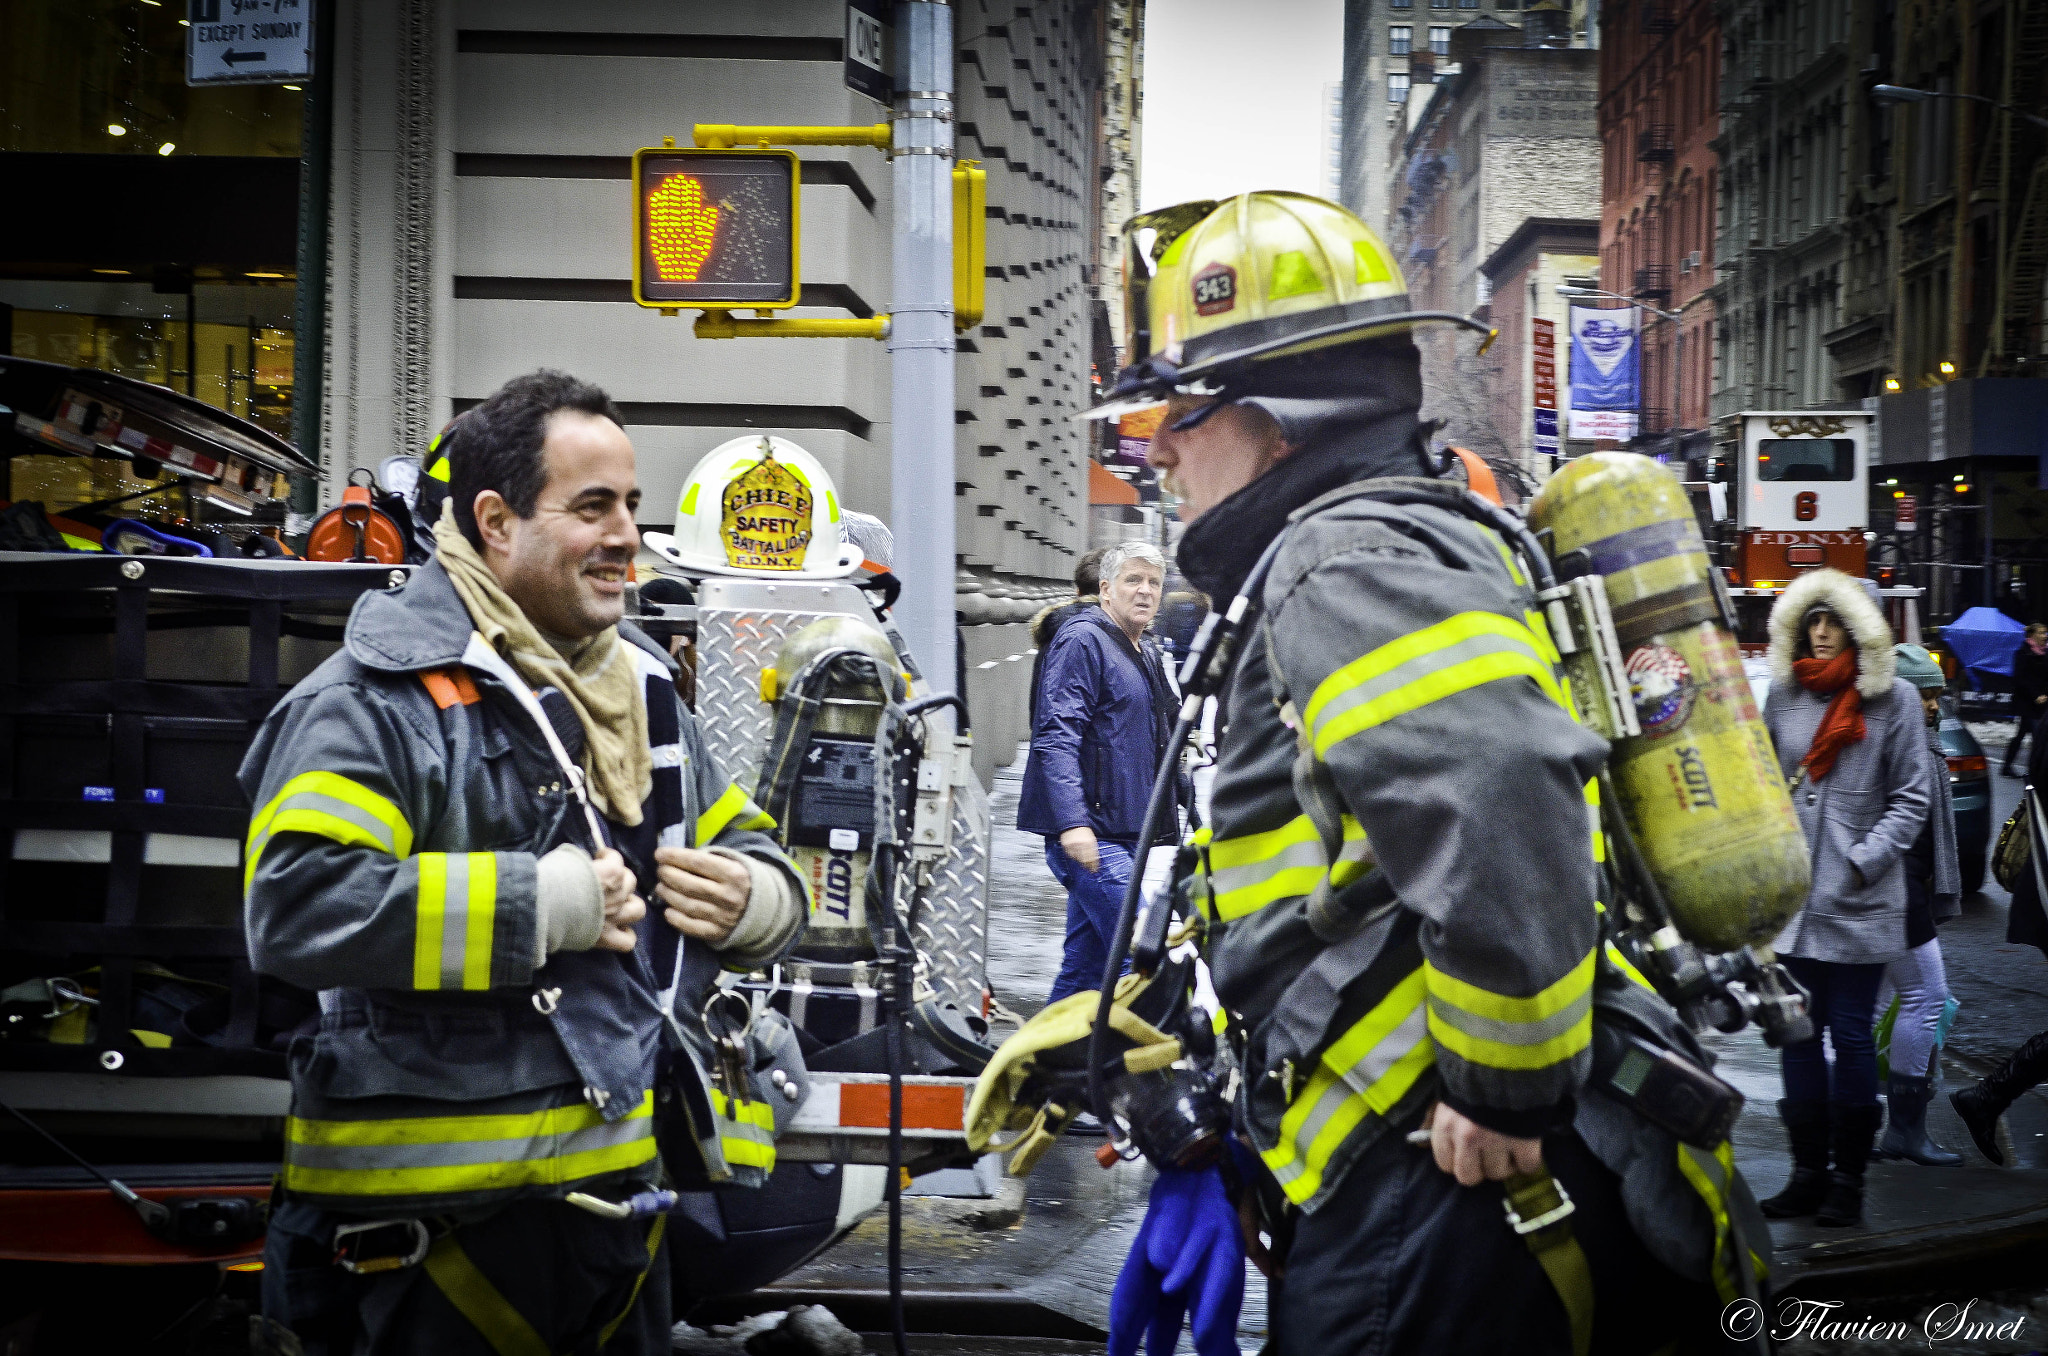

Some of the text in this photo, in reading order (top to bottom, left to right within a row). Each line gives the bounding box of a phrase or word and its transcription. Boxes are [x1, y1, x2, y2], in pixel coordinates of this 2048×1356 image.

[198, 21, 302, 42] EXCEPT SUNDAY
[1196, 274, 1231, 303] 343
[730, 488, 811, 517] CHIEF
[1795, 490, 1819, 522] 6
[736, 515, 799, 534] SAFETY
[1751, 532, 1864, 545] F.D.N.Y.
[728, 531, 808, 555] BATTALION
[1675, 747, 1718, 809] SCOTT
[826, 847, 853, 921] SCOTT
